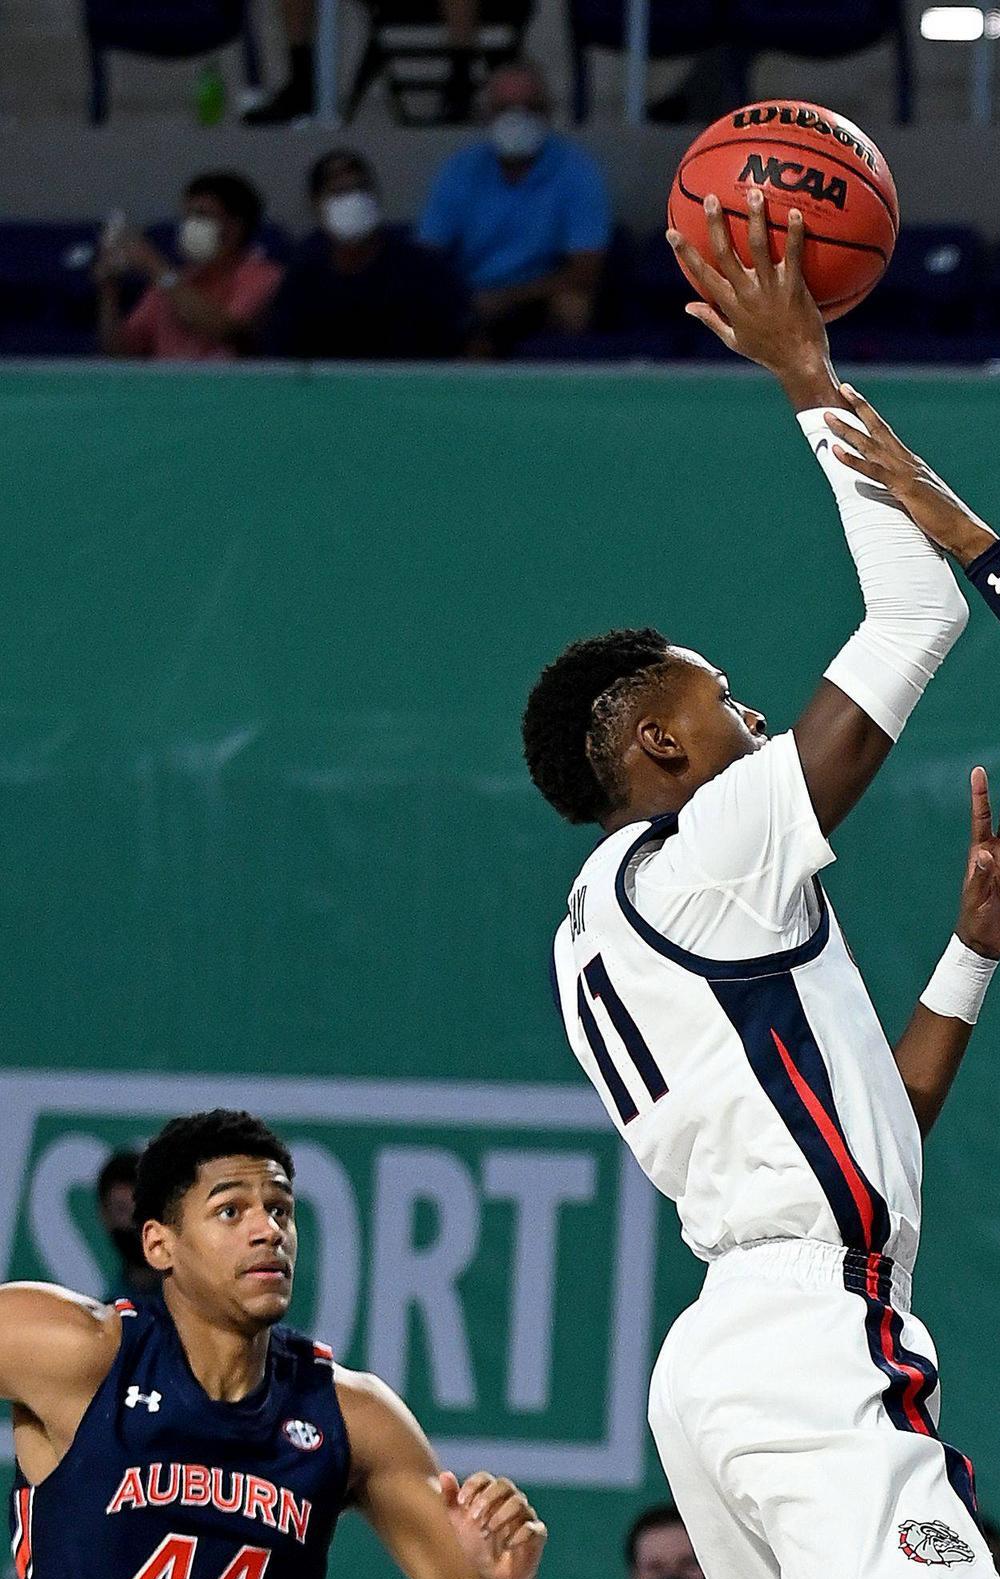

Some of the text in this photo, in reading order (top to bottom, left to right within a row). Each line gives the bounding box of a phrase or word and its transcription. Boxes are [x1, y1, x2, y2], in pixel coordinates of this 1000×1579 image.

[737, 153, 848, 210] NCAA
[577, 951, 670, 1126] 11
[28, 1131, 597, 1414] SORT
[105, 1462, 312, 1545] AUBURN
